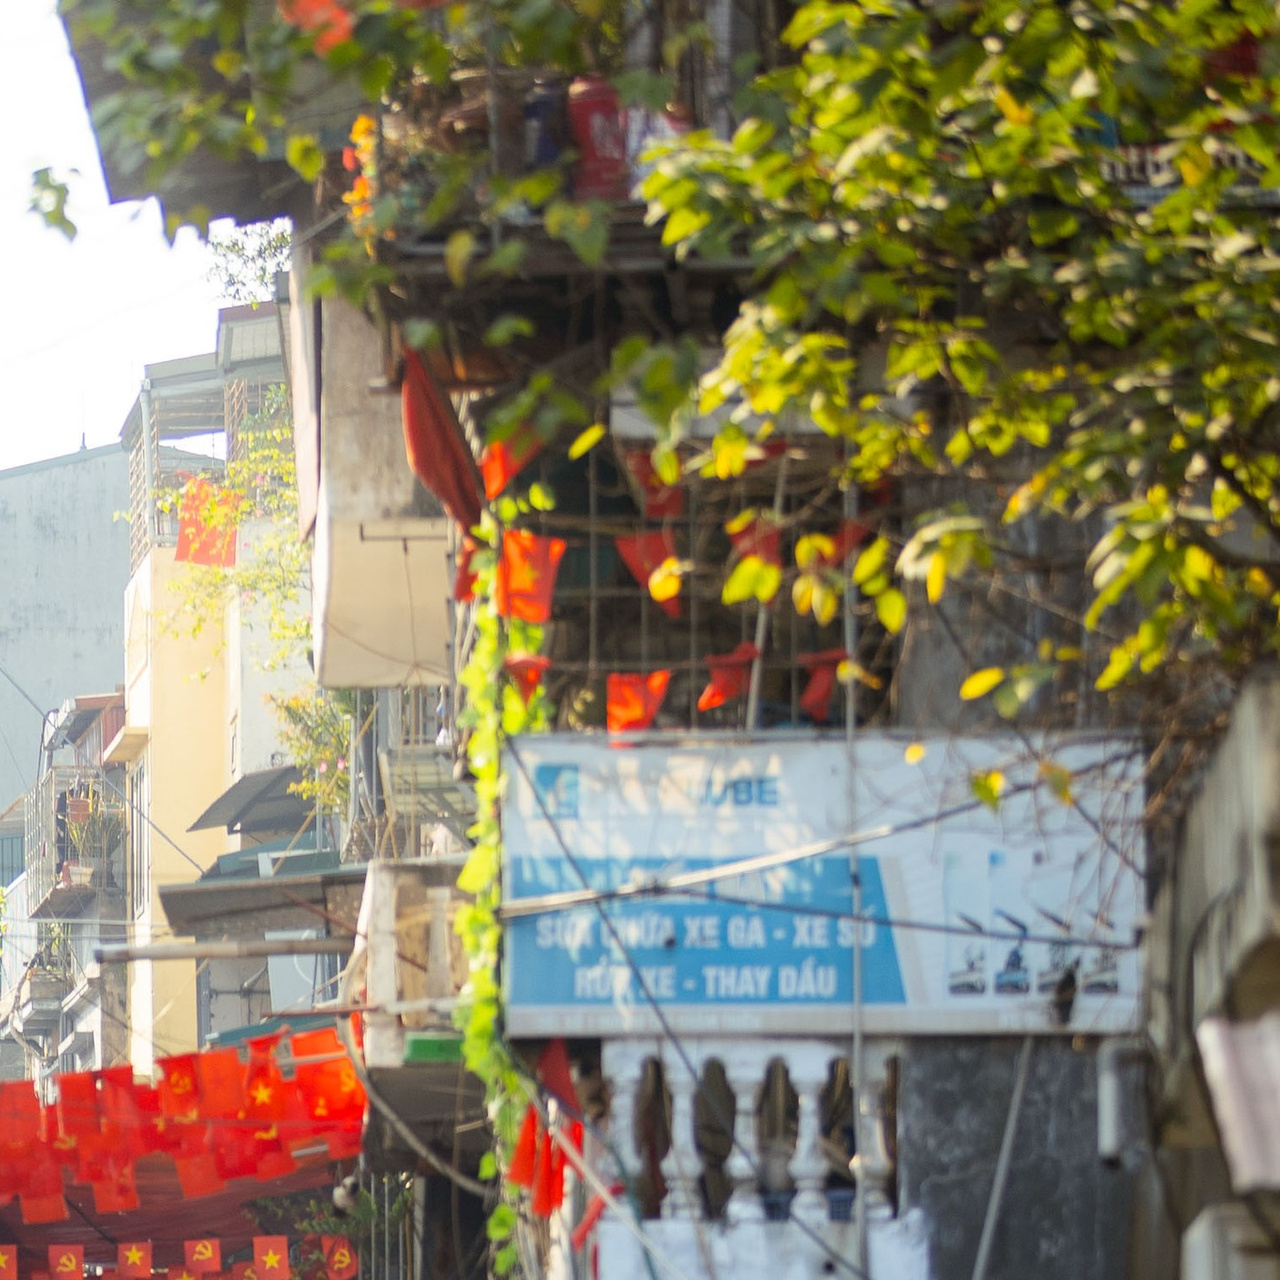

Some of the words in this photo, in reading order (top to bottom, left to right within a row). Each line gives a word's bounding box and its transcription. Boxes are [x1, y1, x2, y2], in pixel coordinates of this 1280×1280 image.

[683, 914, 721, 949] XE
[727, 913, 766, 949] GA
[793, 914, 831, 948] XE
[701, 965, 772, 999] THAY
